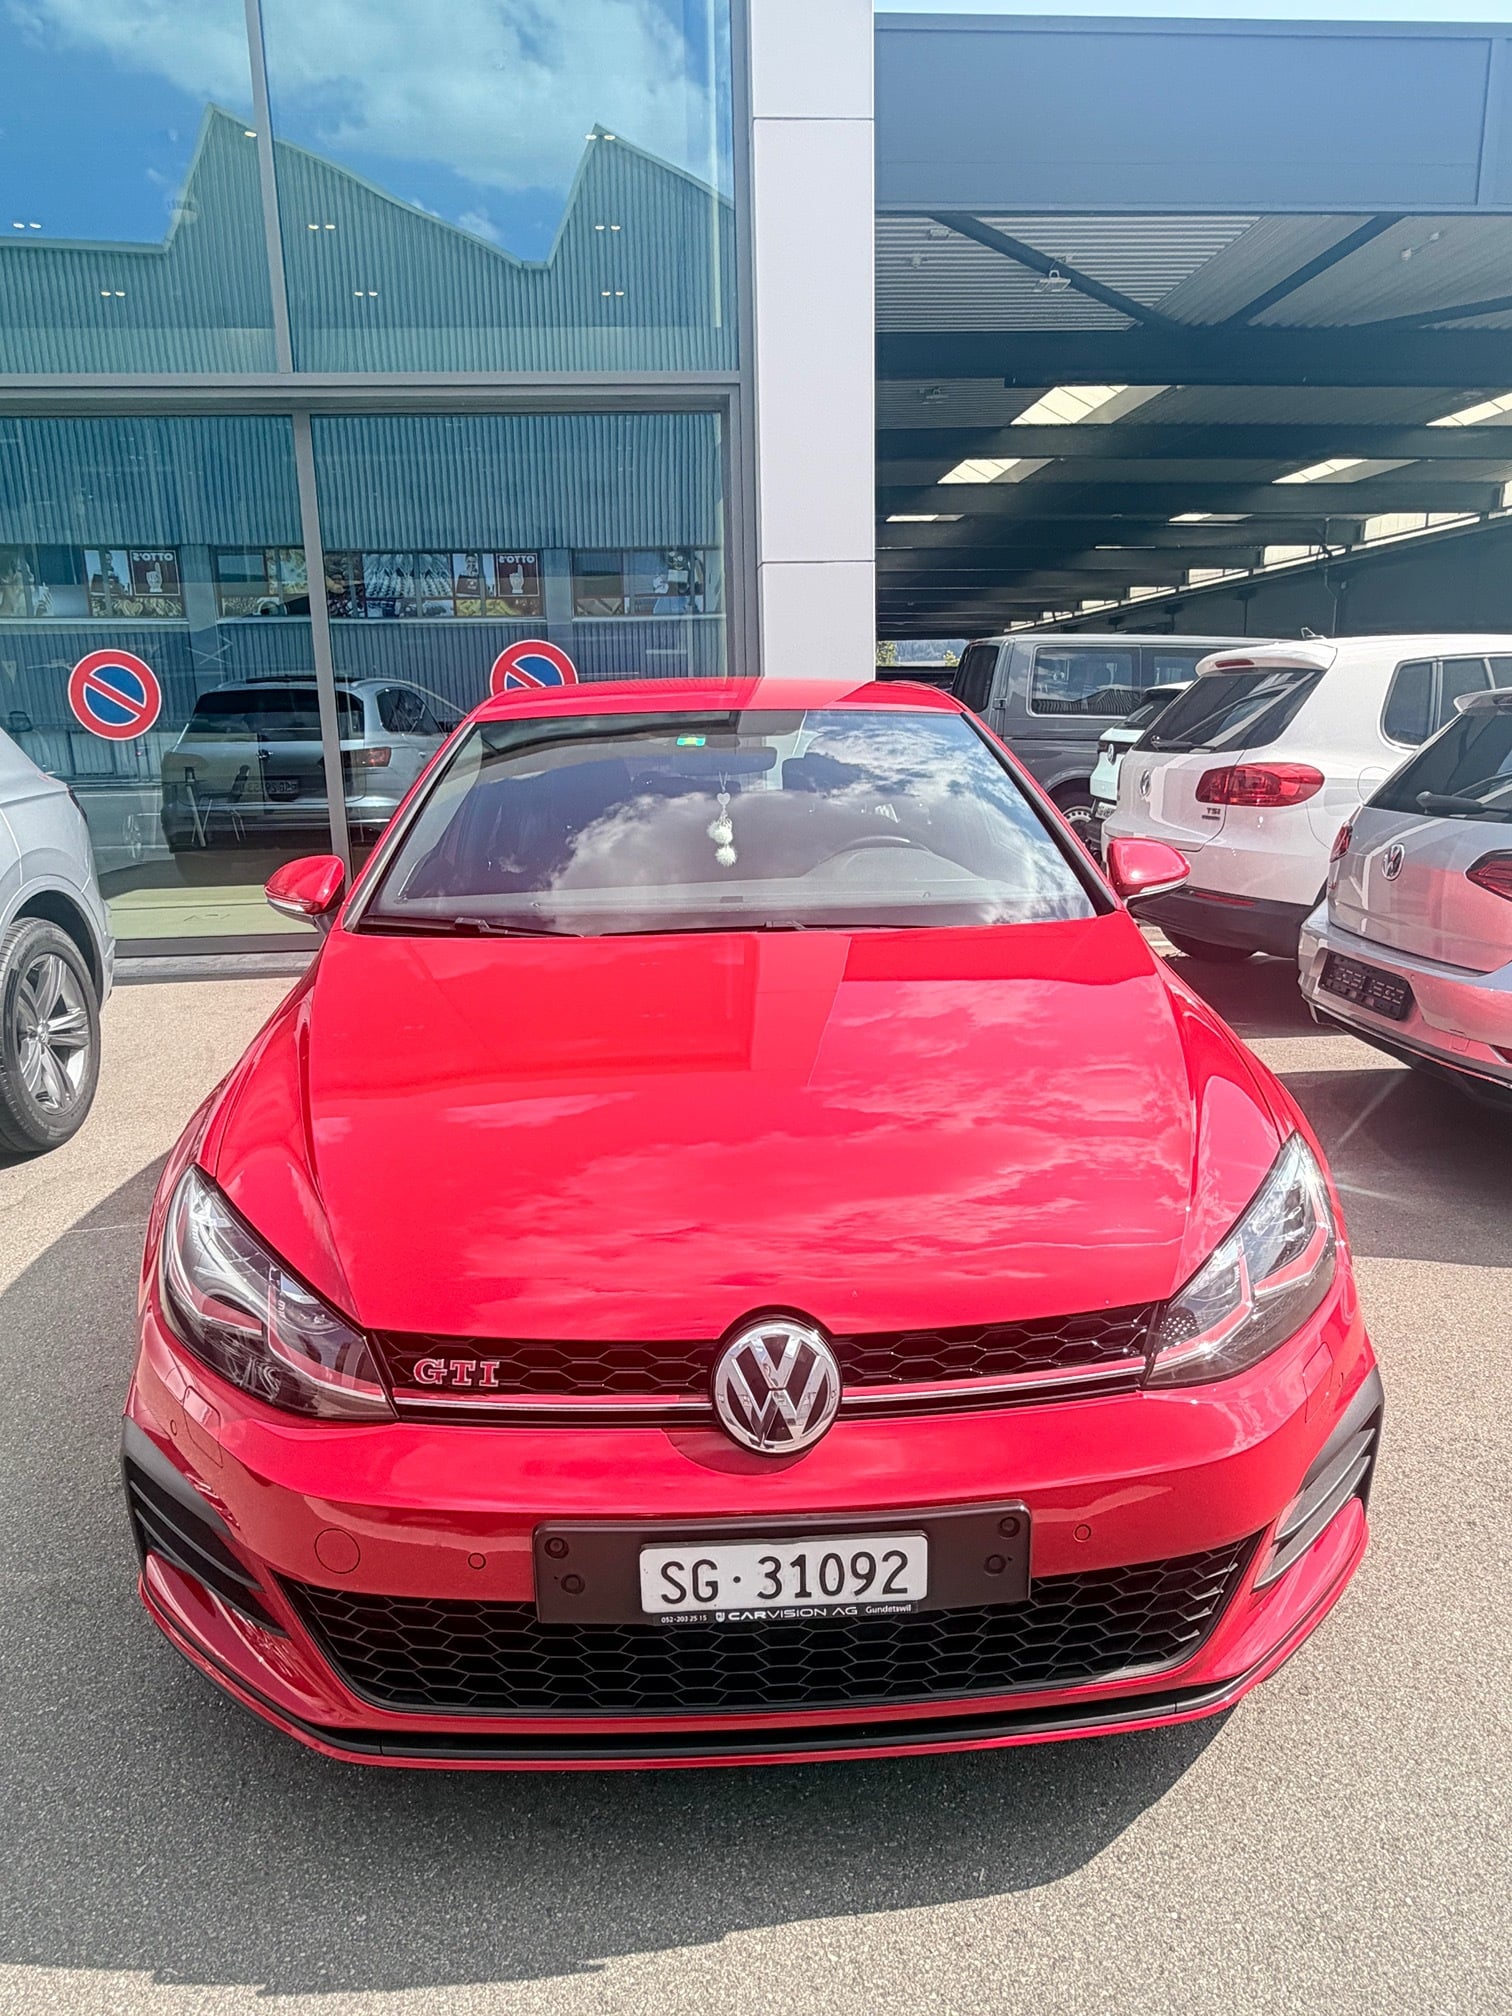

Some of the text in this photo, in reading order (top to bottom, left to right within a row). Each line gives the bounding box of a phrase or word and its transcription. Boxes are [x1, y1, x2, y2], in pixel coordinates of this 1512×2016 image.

[1206, 807, 1221, 815] TSI
[413, 1358, 500, 1387] GTI
[661, 1559, 719, 1604] SG
[756, 1550, 909, 1600] 31092
[727, 1607, 827, 1621] CARVISION
[831, 1606, 858, 1616] AG
